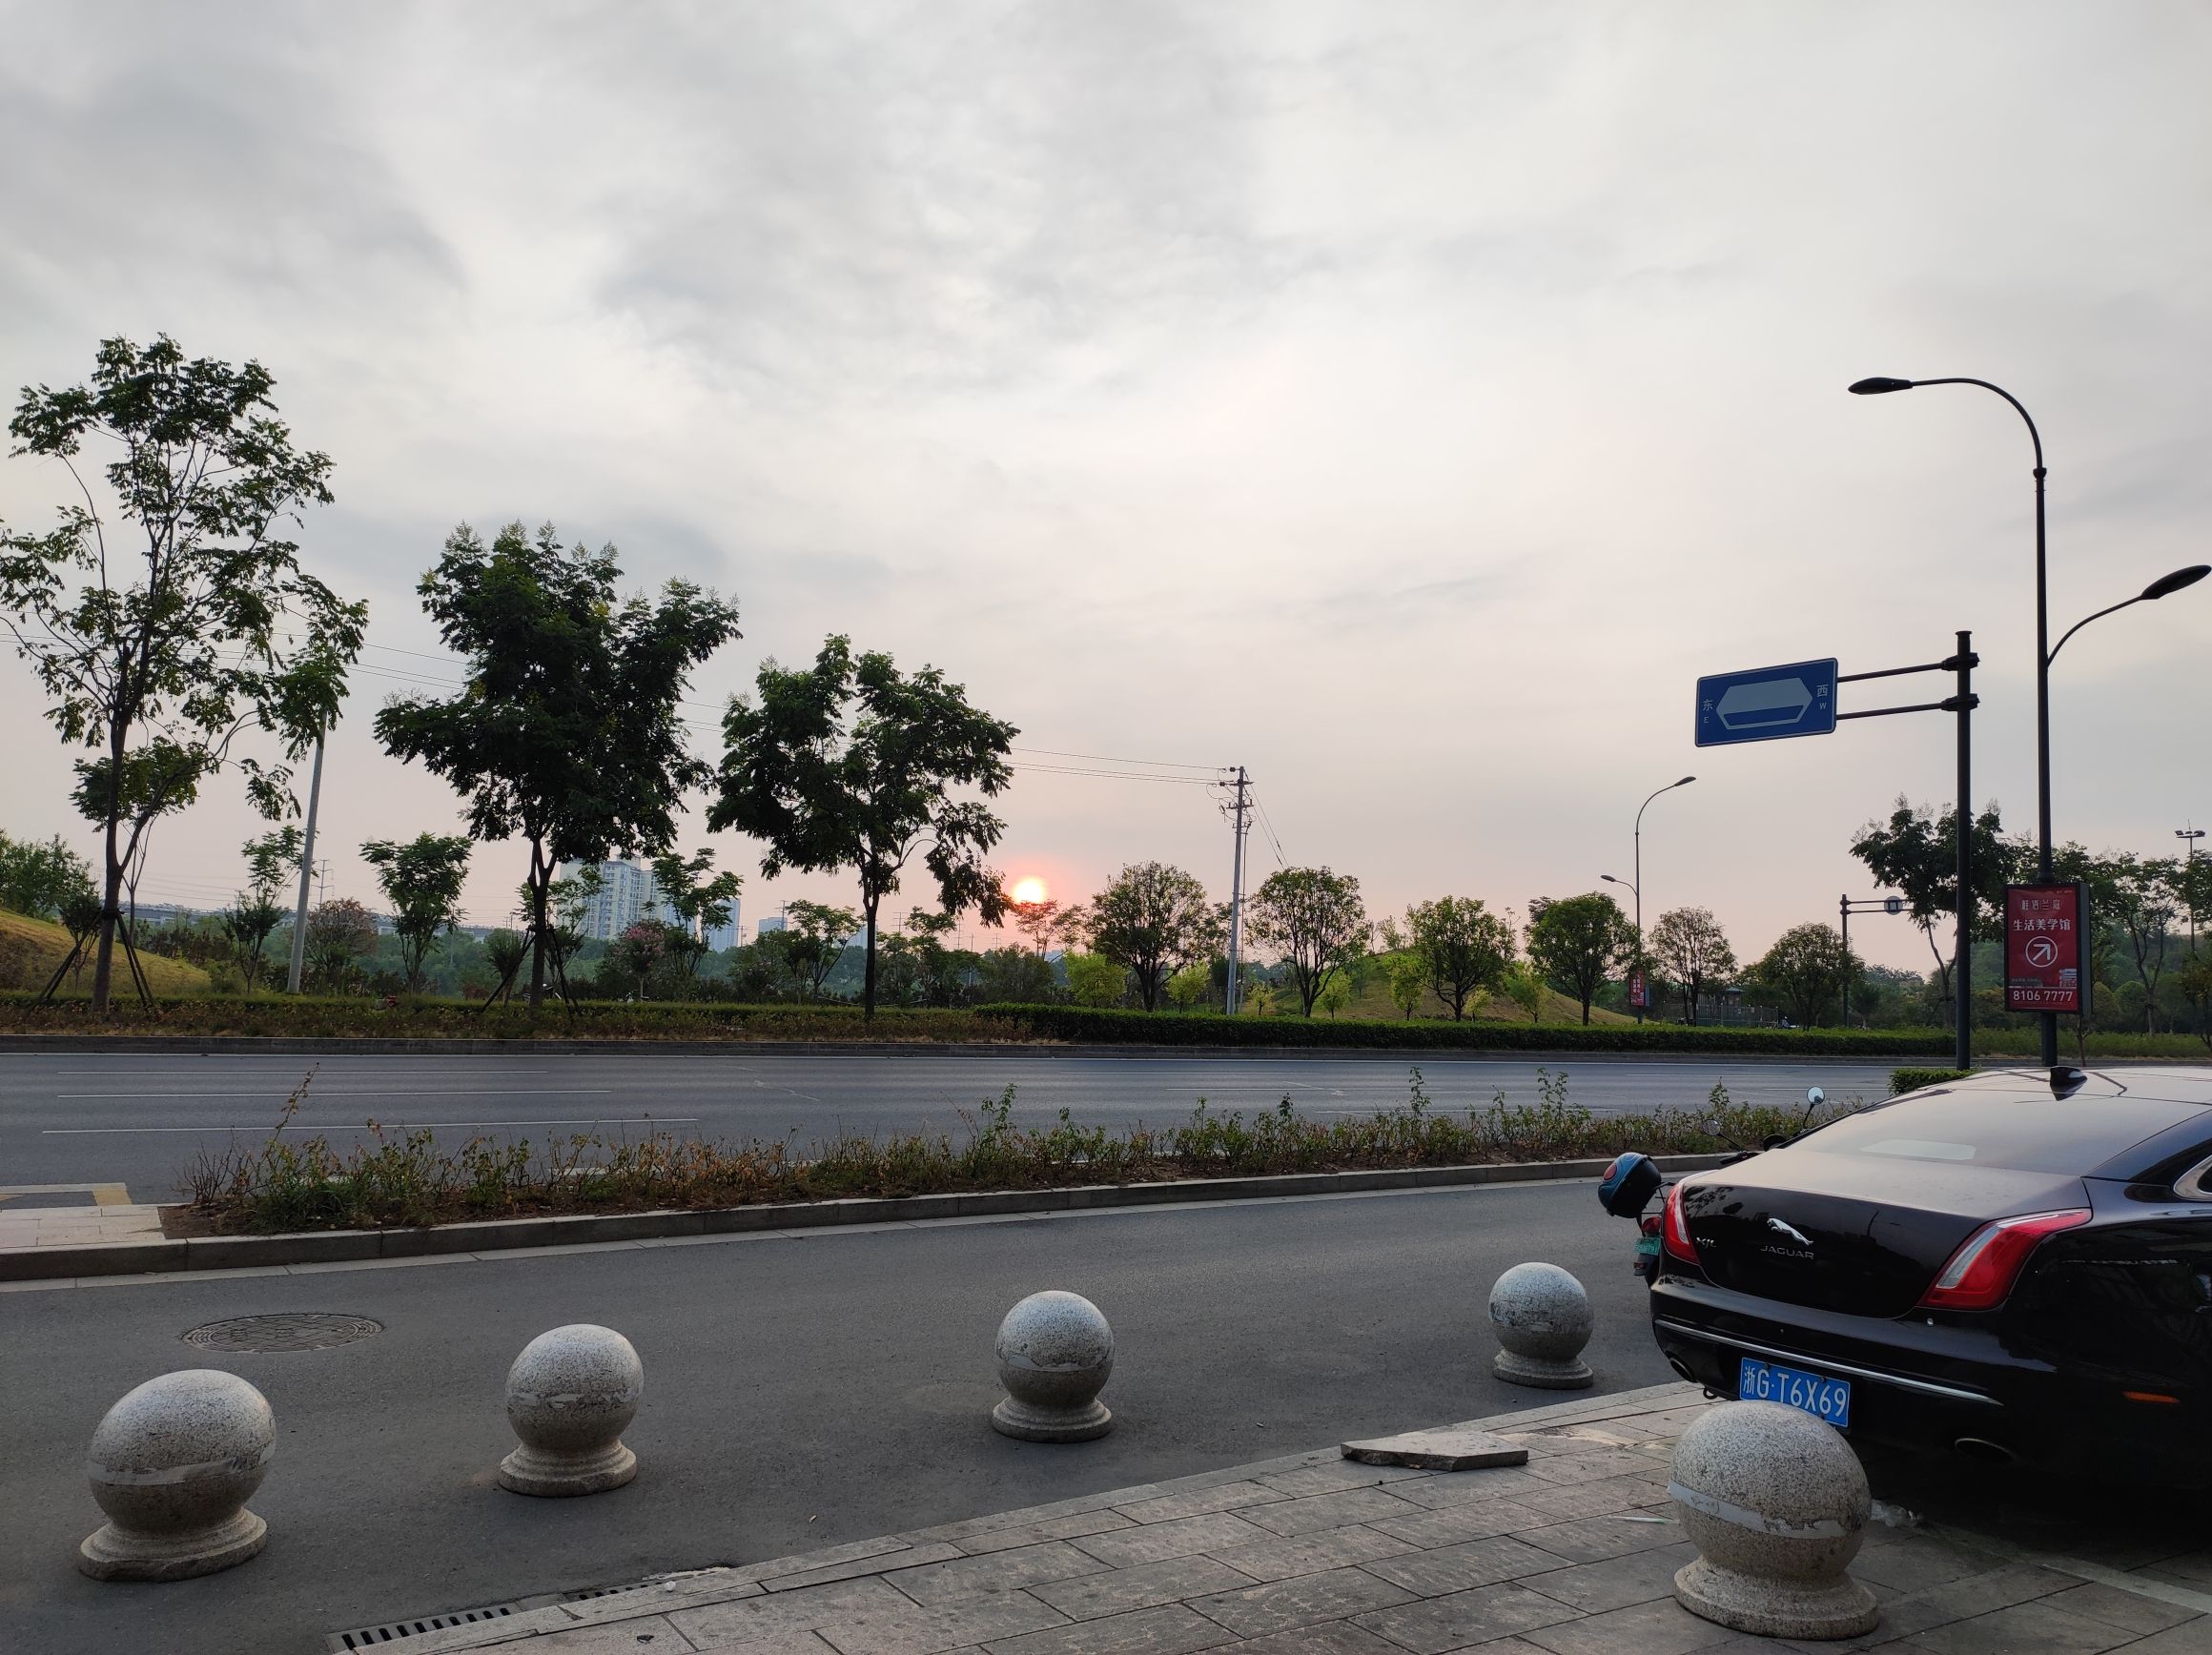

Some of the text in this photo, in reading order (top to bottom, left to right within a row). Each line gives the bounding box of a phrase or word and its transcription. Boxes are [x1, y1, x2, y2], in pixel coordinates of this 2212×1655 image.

[1816, 684, 1829, 698] 西
[1702, 699, 1713, 711] 东
[1819, 702, 1827, 710] W
[2013, 918, 2071, 931] 生活美学馆
[2013, 990, 2073, 1002] 8106 7777
[1760, 1245, 1814, 1259] JAGUAR
